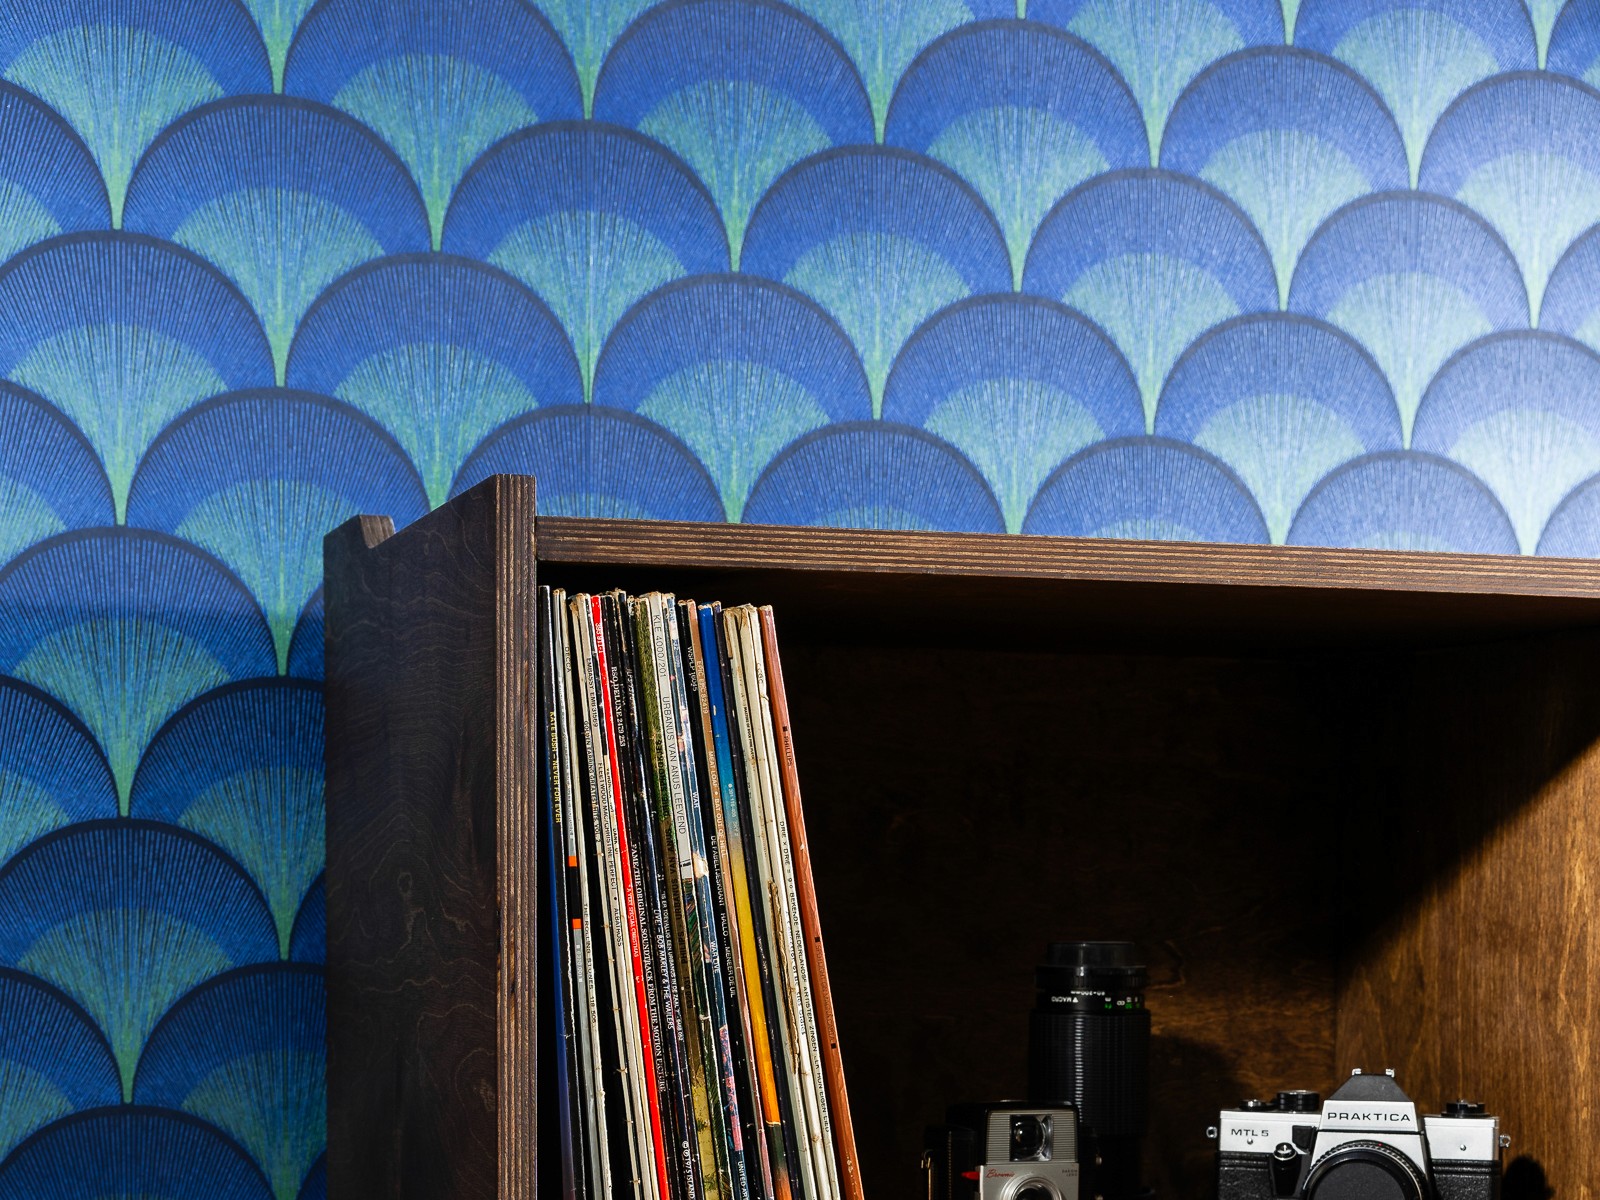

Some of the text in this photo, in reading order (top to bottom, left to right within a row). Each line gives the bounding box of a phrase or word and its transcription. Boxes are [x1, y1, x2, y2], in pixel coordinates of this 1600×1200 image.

[586, 657, 594, 689] EMBASSY
[613, 683, 621, 716] DELUXE
[700, 693, 708, 713] 82419
[653, 614, 685, 834] KLE 4000/201 URBANUS VAN ANUS LEEVEND
[707, 750, 715, 768] MEAT
[720, 840, 728, 858] HELL
[597, 762, 606, 804] FLEETWOOD
[602, 805, 612, 858] MAC/CHRISTINE
[608, 860, 616, 890] PERFECT
[613, 907, 622, 946] ALBATROSS
[636, 887, 646, 927] ORIGINAL
[664, 828, 687, 964] PHILIPS URBANUS VAN ANUS
[711, 846, 724, 906] FABELTJESKRANT
[724, 946, 733, 975] MENEER
[662, 909, 670, 938] TOEVALLIG
[640, 928, 652, 981] SOUNDTRACK
[712, 957, 720, 973] LIVE
[782, 848, 790, 865] DRIE
[789, 892, 798, 925] BEKENDE
[803, 986, 812, 1022] ARTISTEN
[809, 1025, 817, 1051] ZINGEN
[647, 983, 655, 1005] FROM
[658, 950, 667, 976] MARLEY
[664, 1000, 673, 1029] WAILERS
[652, 1025, 661, 1056] MOTION
[656, 1058, 665, 1092] PICTURE
[1231, 1129, 1258, 1137] MTL
[1327, 1112, 1410, 1122] PRAKTICA
[686, 1173, 694, 1198] ISLAND
[737, 1160, 746, 1186] UNITED
